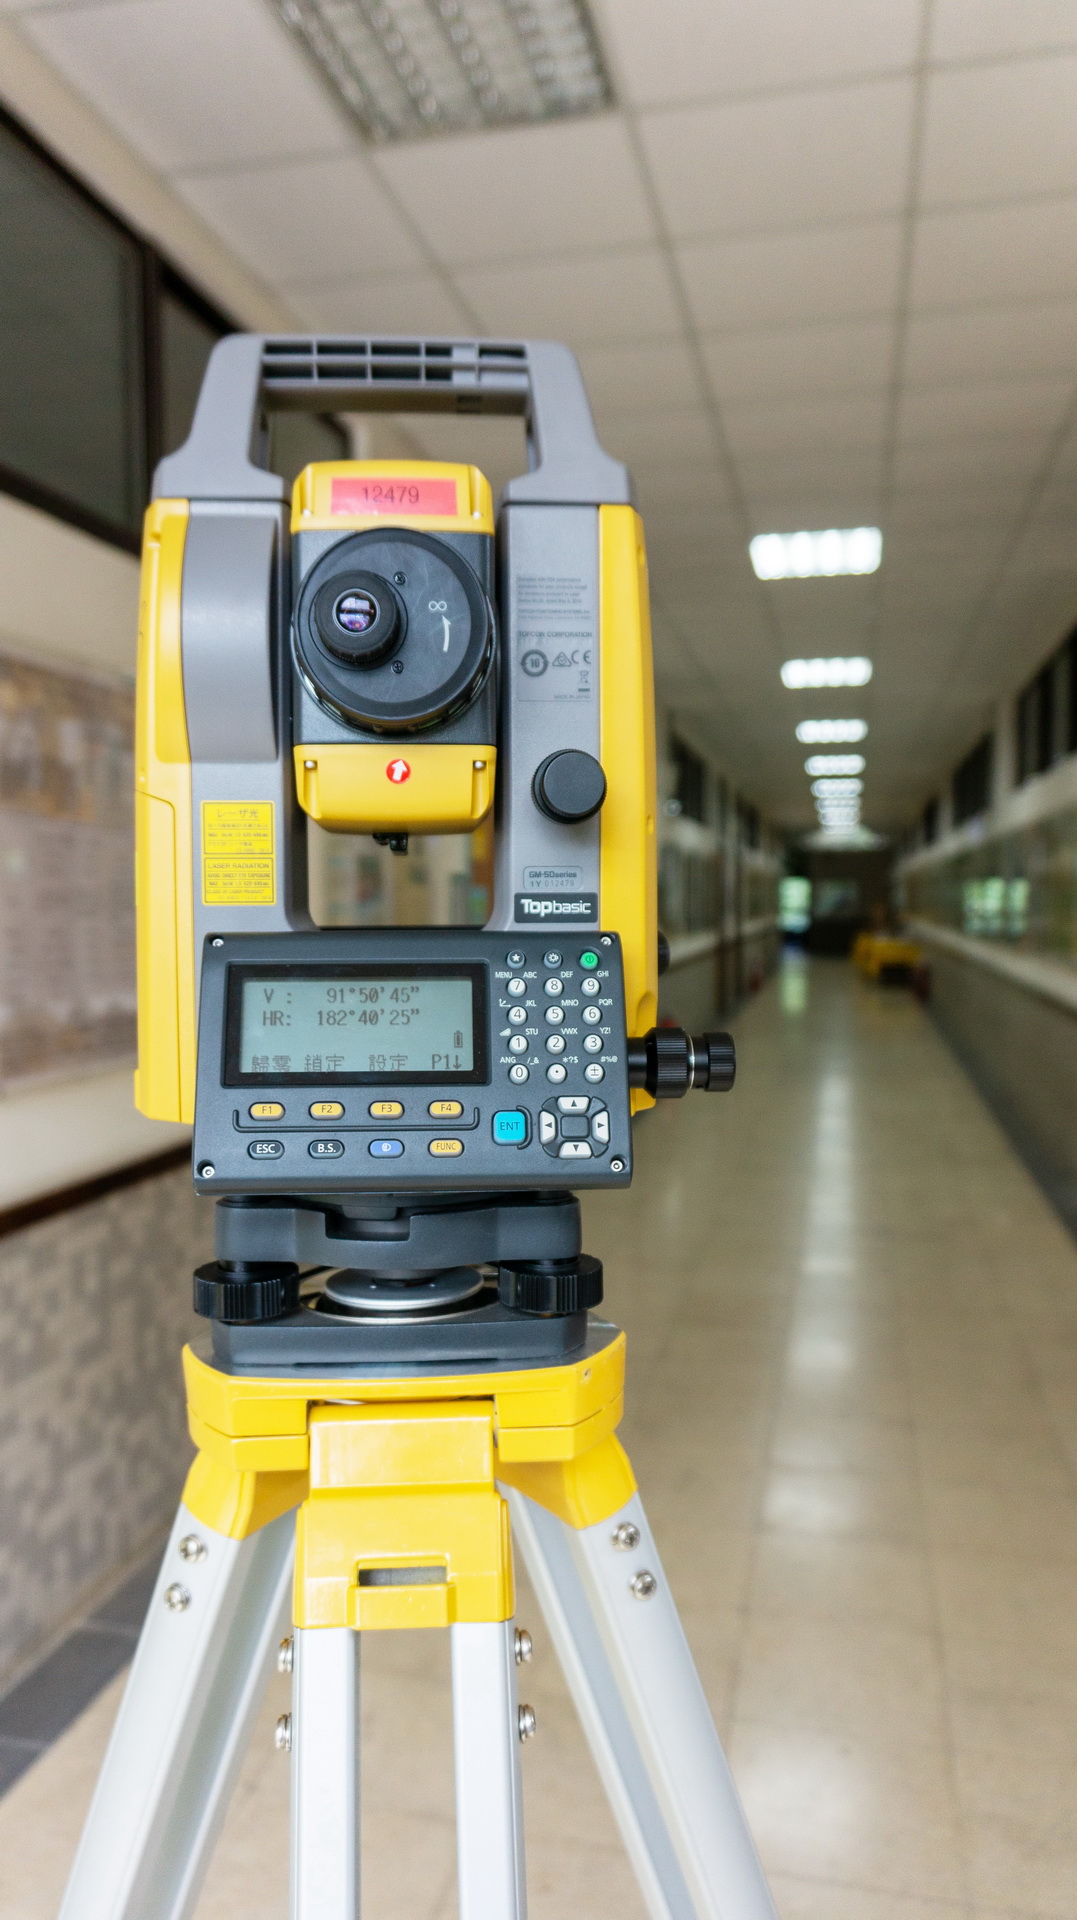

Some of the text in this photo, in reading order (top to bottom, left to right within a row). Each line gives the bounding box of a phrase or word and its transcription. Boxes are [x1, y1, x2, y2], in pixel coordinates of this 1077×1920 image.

[362, 485, 420, 504] 12479
[530, 658, 540, 668] 10
[520, 899, 591, 917] Topbasic
[596, 970, 609, 978] GHI
[514, 981, 521, 991] 7
[550, 980, 559, 990] 8
[587, 980, 595, 991] 9
[263, 988, 275, 1004] V
[561, 999, 579, 1007] MNO
[262, 1010, 292, 1026] HR:
[513, 1009, 522, 1019] 4
[552, 1008, 559, 1019] 5
[588, 1008, 596, 1019] 6
[515, 1037, 521, 1048] 1
[552, 1037, 560, 1048] 2
[590, 1037, 598, 1048] 3
[499, 1056, 517, 1064] ANG
[515, 1066, 523, 1078] 0
[262, 1106, 272, 1114] F1
[321, 1105, 333, 1114] F2
[381, 1104, 393, 1113] F3
[440, 1103, 452, 1112] F4
[500, 1121, 520, 1131] ENT
[256, 1143, 275, 1154] ESC
[317, 1143, 336, 1153] B.S.
[436, 1142, 456, 1151] FUNC
